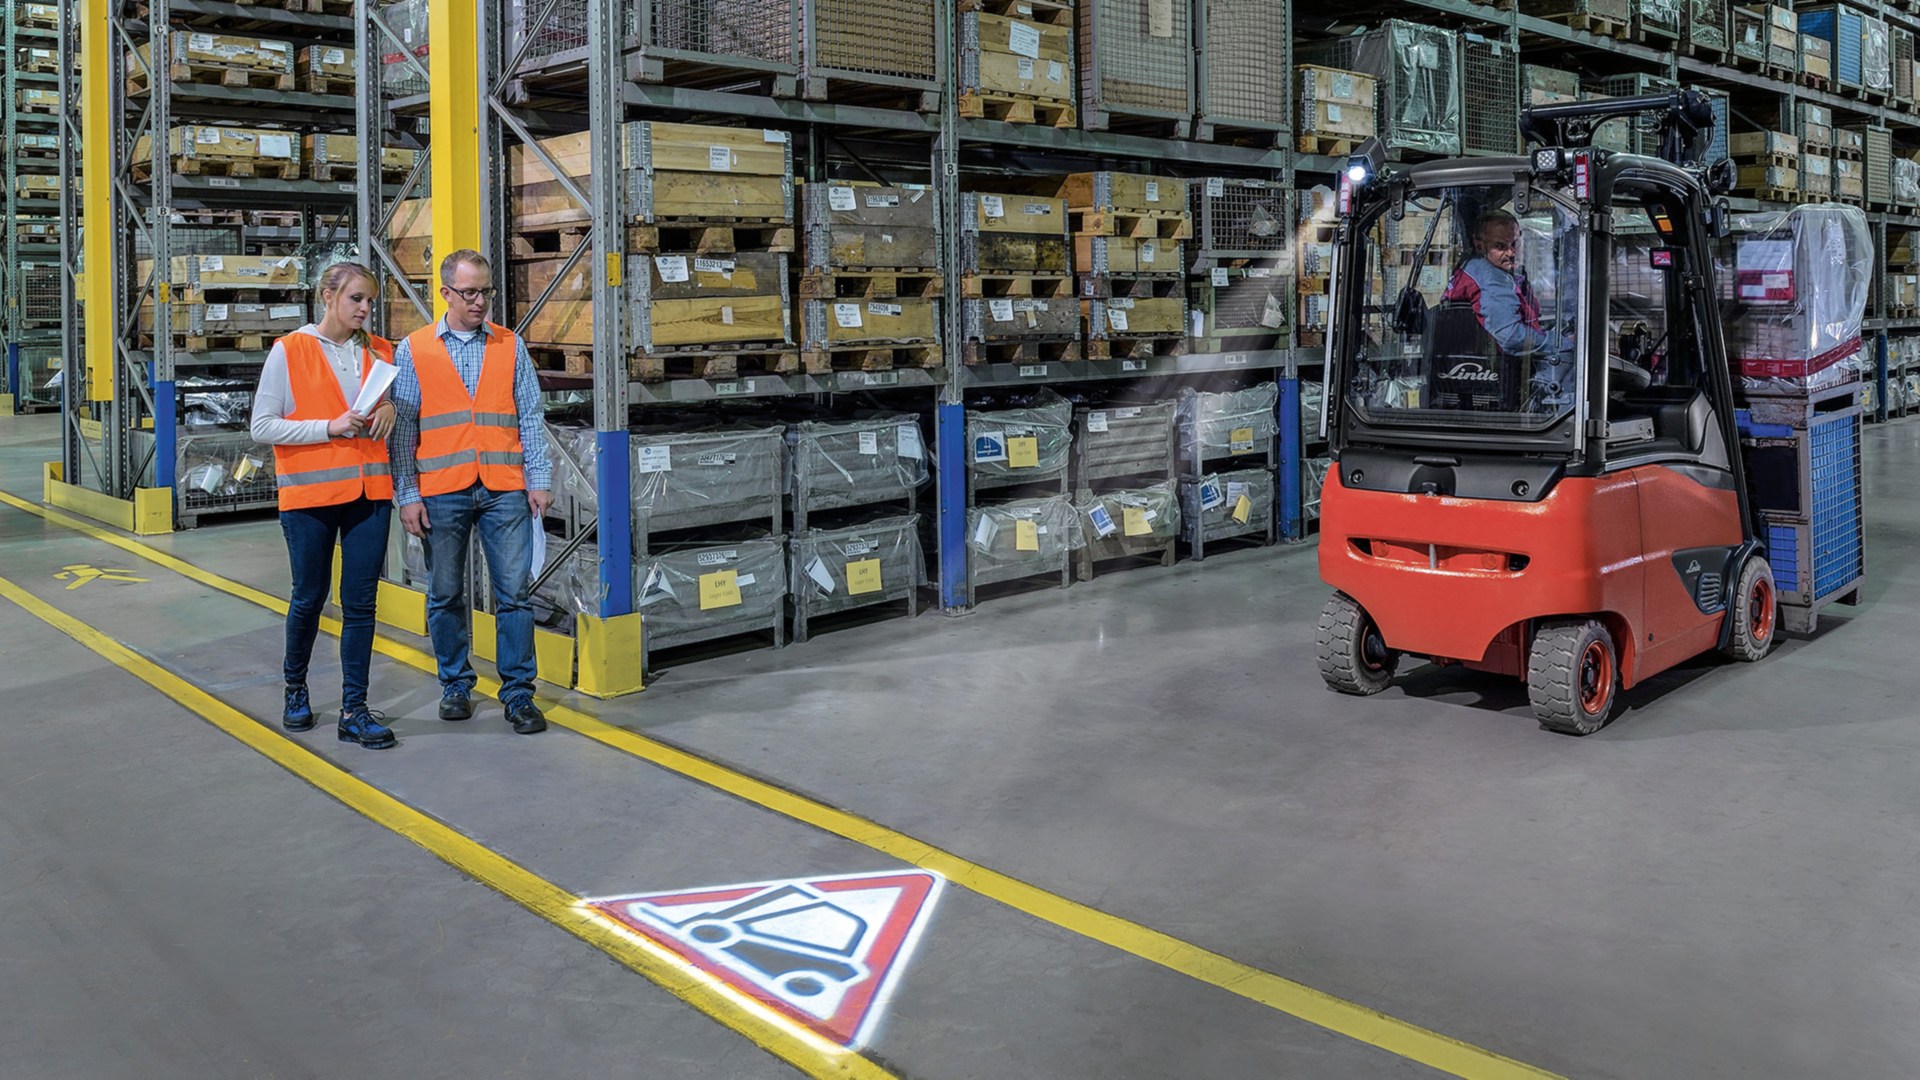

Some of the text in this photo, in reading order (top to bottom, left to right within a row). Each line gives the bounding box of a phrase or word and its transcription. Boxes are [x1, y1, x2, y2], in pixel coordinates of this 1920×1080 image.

[156, 26, 163, 34] C
[948, 164, 954, 175] B
[160, 207, 167, 215] B
[1437, 362, 1499, 381] Linde
